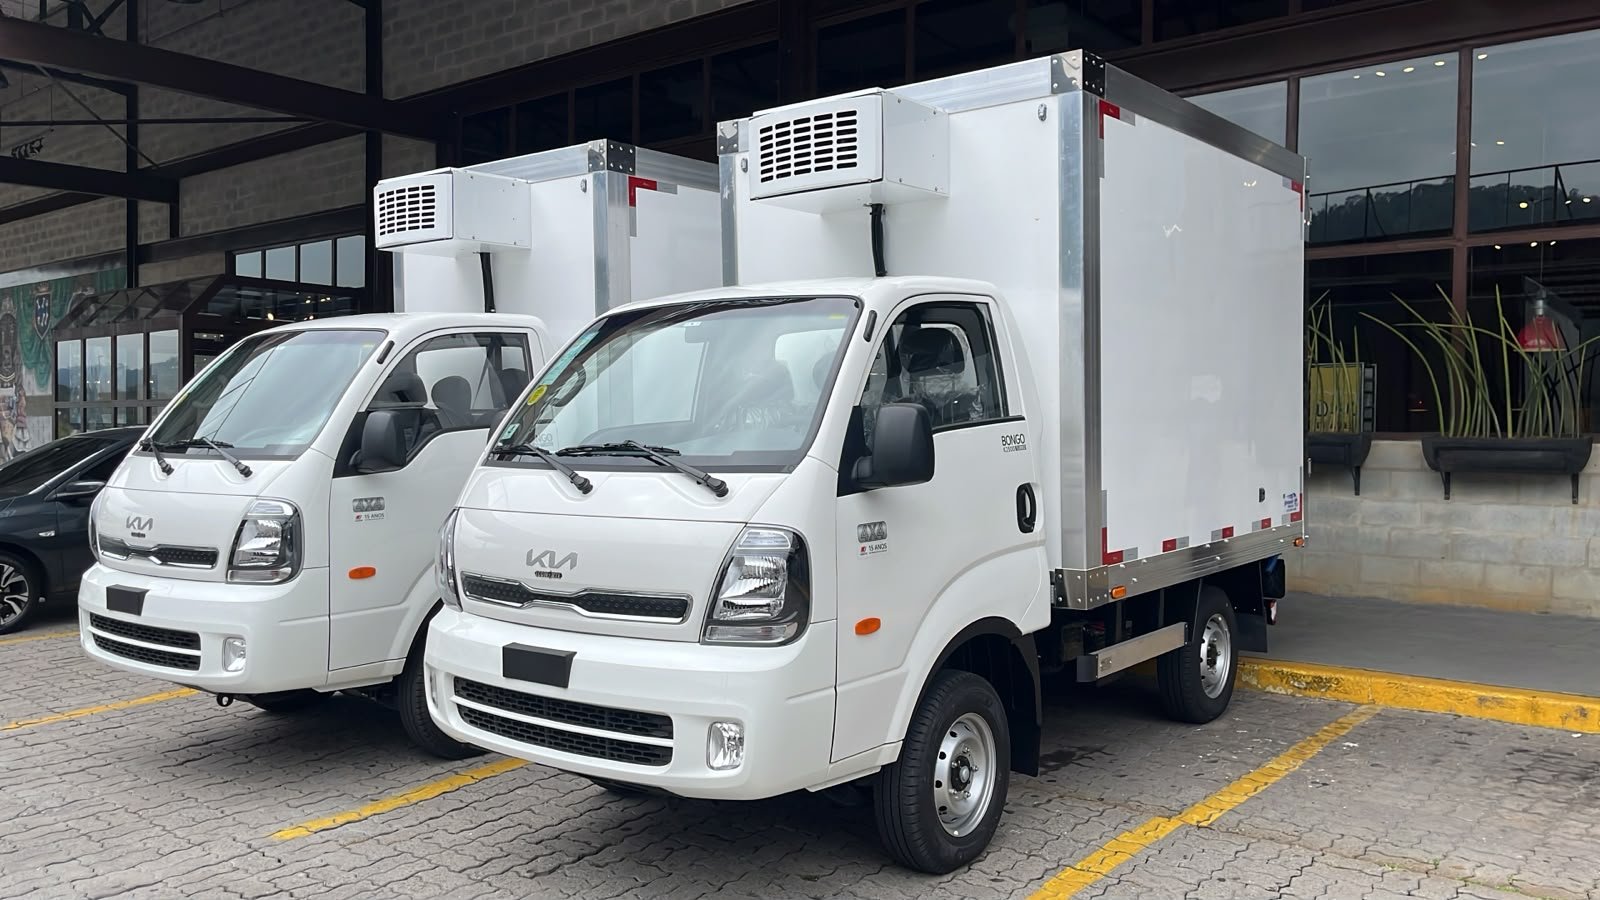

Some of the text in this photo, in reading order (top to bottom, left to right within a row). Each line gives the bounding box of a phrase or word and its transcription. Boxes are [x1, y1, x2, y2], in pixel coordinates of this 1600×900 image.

[1001, 433, 1026, 446] BONGO
[125, 516, 153, 531] KIA
[874, 543, 888, 551] ANOS
[526, 548, 578, 570] KIA
